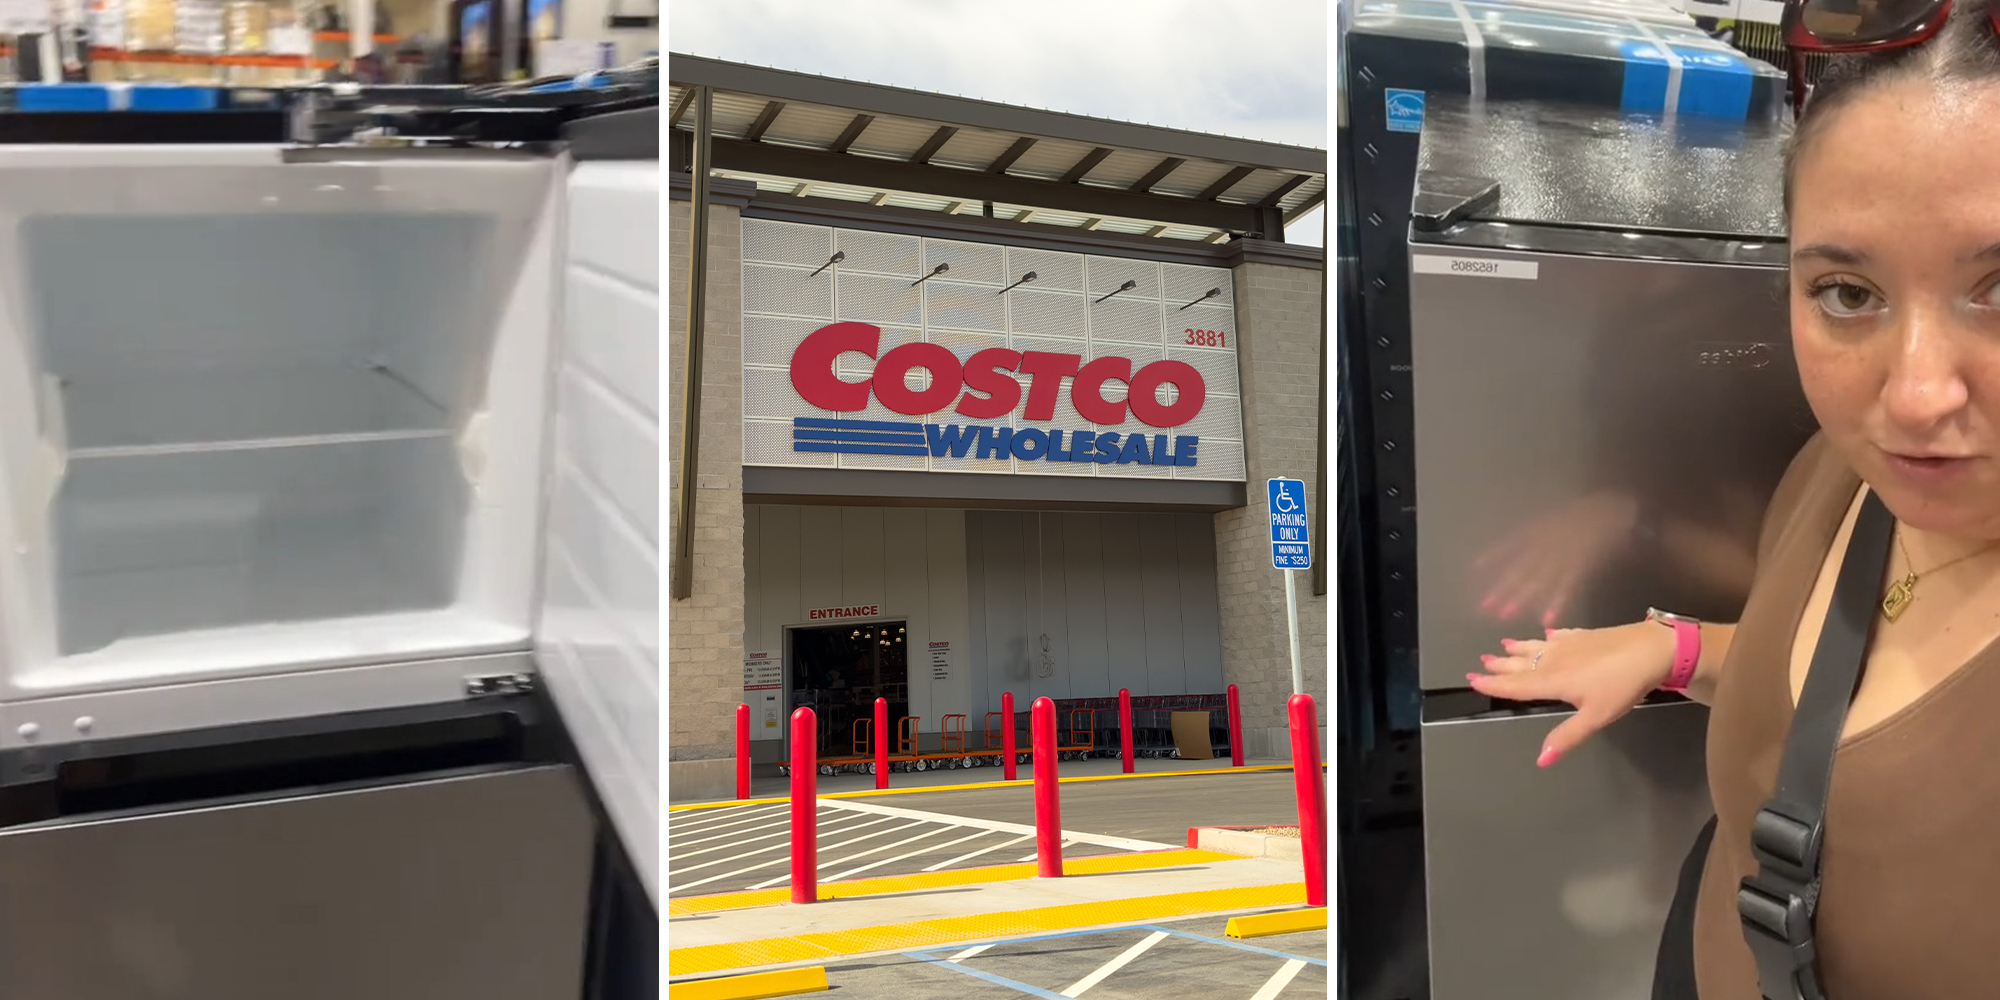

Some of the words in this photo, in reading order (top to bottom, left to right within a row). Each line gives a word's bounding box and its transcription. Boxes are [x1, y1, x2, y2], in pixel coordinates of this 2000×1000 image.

[1185, 328, 1225, 348] 3881
[790, 321, 1206, 428] COSTCO
[925, 424, 1199, 466] WHOLESALE
[1272, 513, 1305, 526] PARKING
[1280, 527, 1299, 540] ONLY
[1275, 555, 1288, 565] FINE
[810, 605, 878, 619] ENTRANCE
